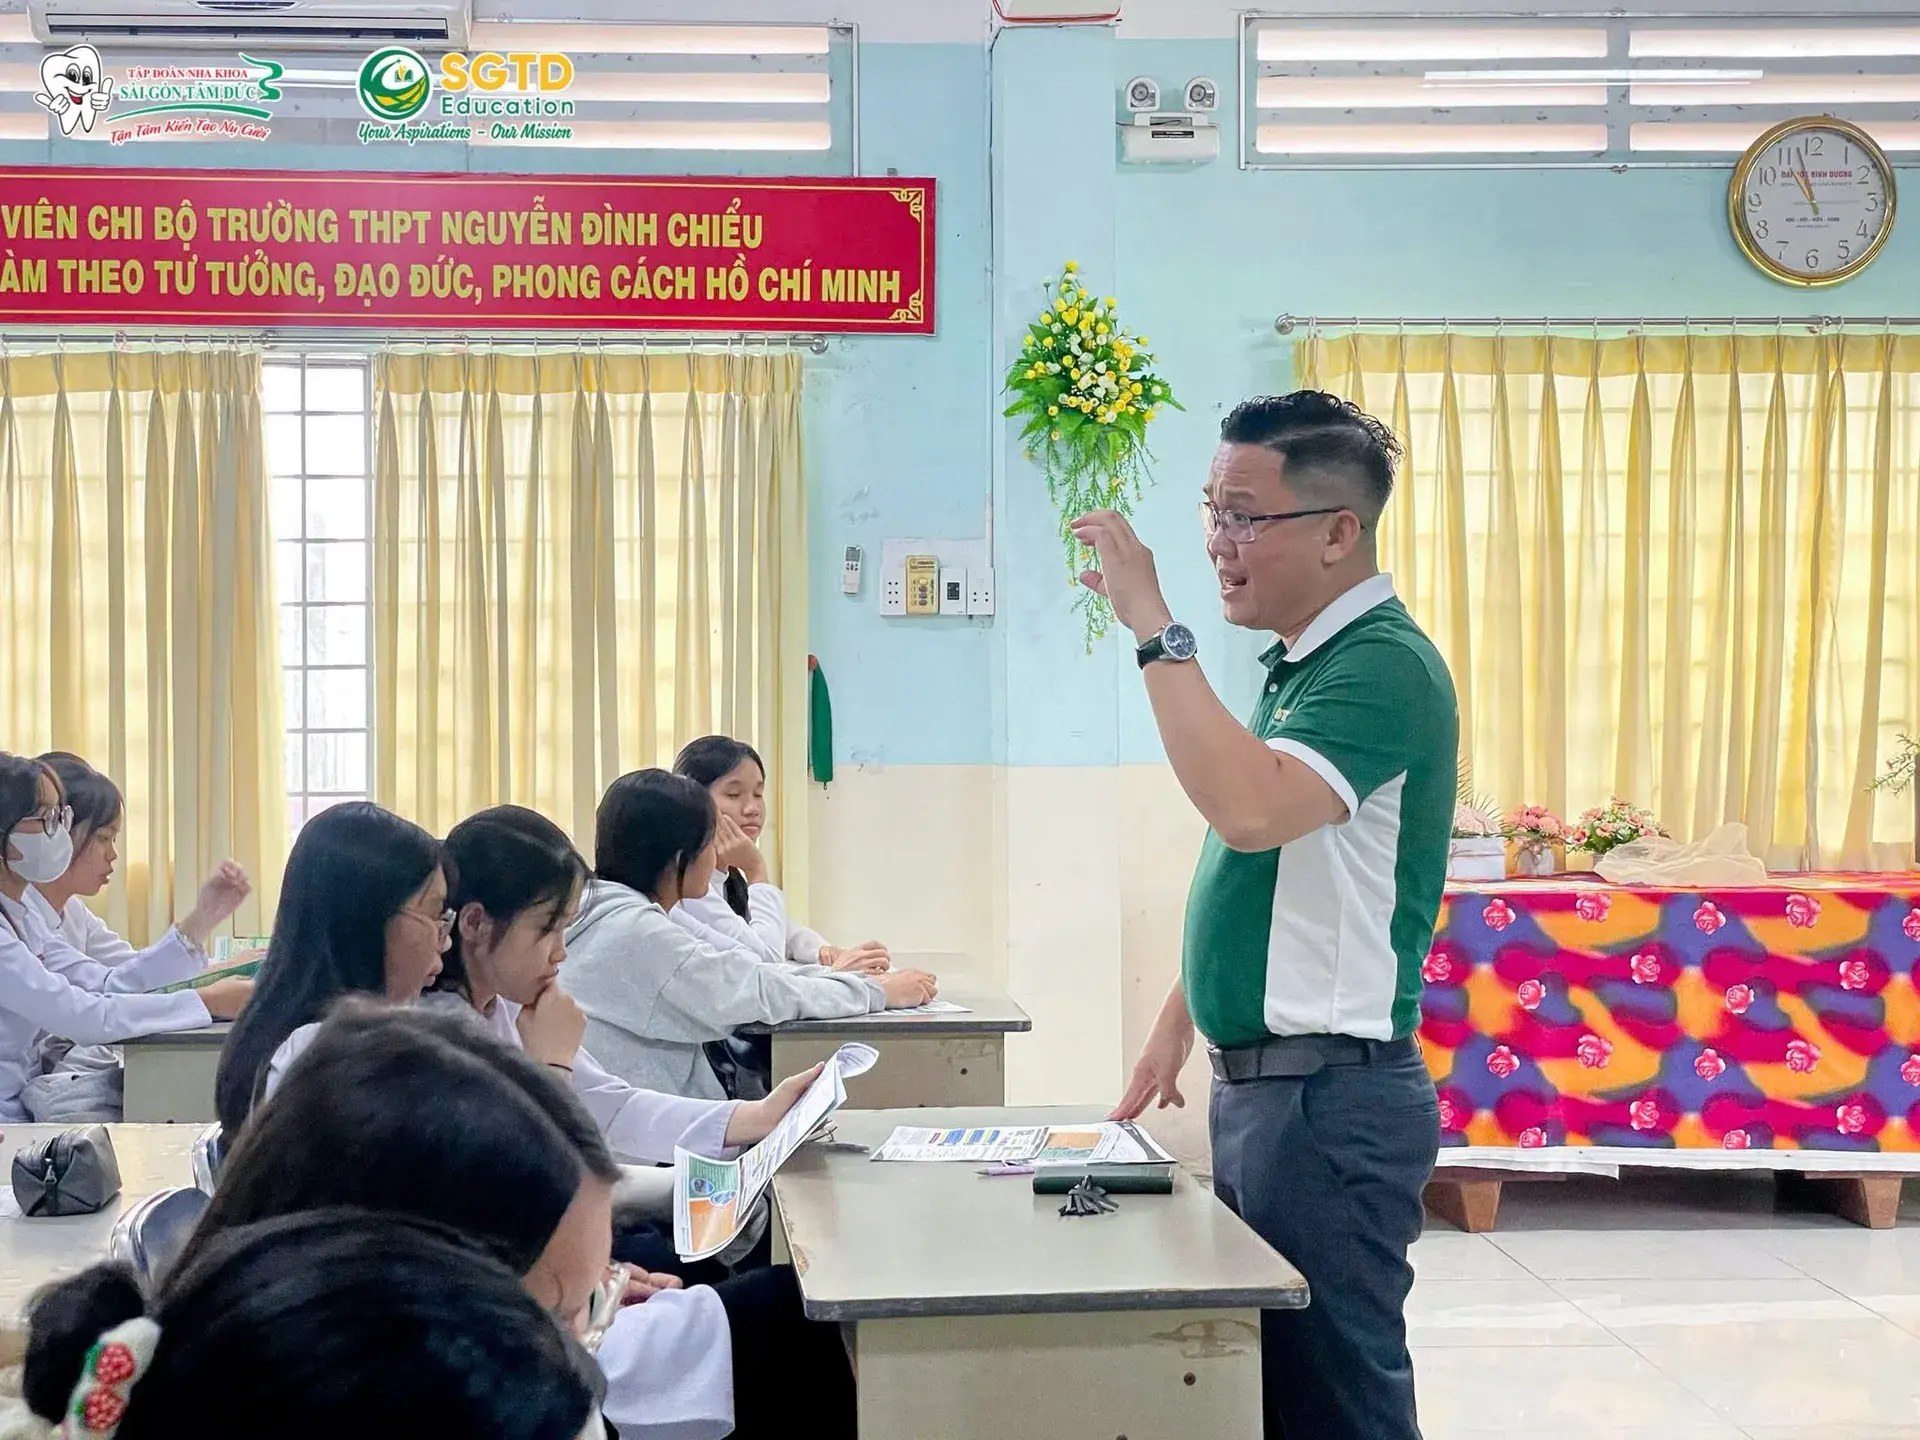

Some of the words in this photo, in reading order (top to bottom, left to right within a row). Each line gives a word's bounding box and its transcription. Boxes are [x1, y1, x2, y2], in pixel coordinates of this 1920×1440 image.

[1805, 136, 1823, 156] 12
[1778, 147, 1791, 166] 11
[1759, 166, 1776, 186] 10
[1856, 165, 1870, 185] 2
[1749, 193, 1762, 212] 9
[1865, 192, 1878, 212] 3
[1, 196, 78, 240] VIÊN
[87, 205, 142, 240] CHI
[154, 199, 197, 251] BỘ
[207, 198, 339, 244] TRƯỜNG
[349, 210, 432, 245] THPT
[441, 195, 571, 246] NGUYỄN
[581, 203, 657, 247] ĐÌNH
[667, 197, 763, 248] CHIỂU
[1756, 220, 1769, 239] 8
[1856, 219, 1868, 239] 4
[1776, 240, 1789, 260] 7
[1805, 249, 1818, 268] 6
[1838, 239, 1850, 260] 5
[0, 248, 47, 293] ÀM
[57, 259, 144, 295] THEO
[154, 253, 198, 296] TƯ
[206, 248, 326, 303] TƯỞNG,
[335, 263, 400, 307] ĐẠO
[409, 254, 483, 305] ĐỨC,
[492, 264, 600, 299] PHONG
[610, 257, 696, 301] CÁCH
[706, 252, 750, 302] HỒ
[758, 259, 811, 302] CHÍ
[821, 269, 900, 303] MINH
